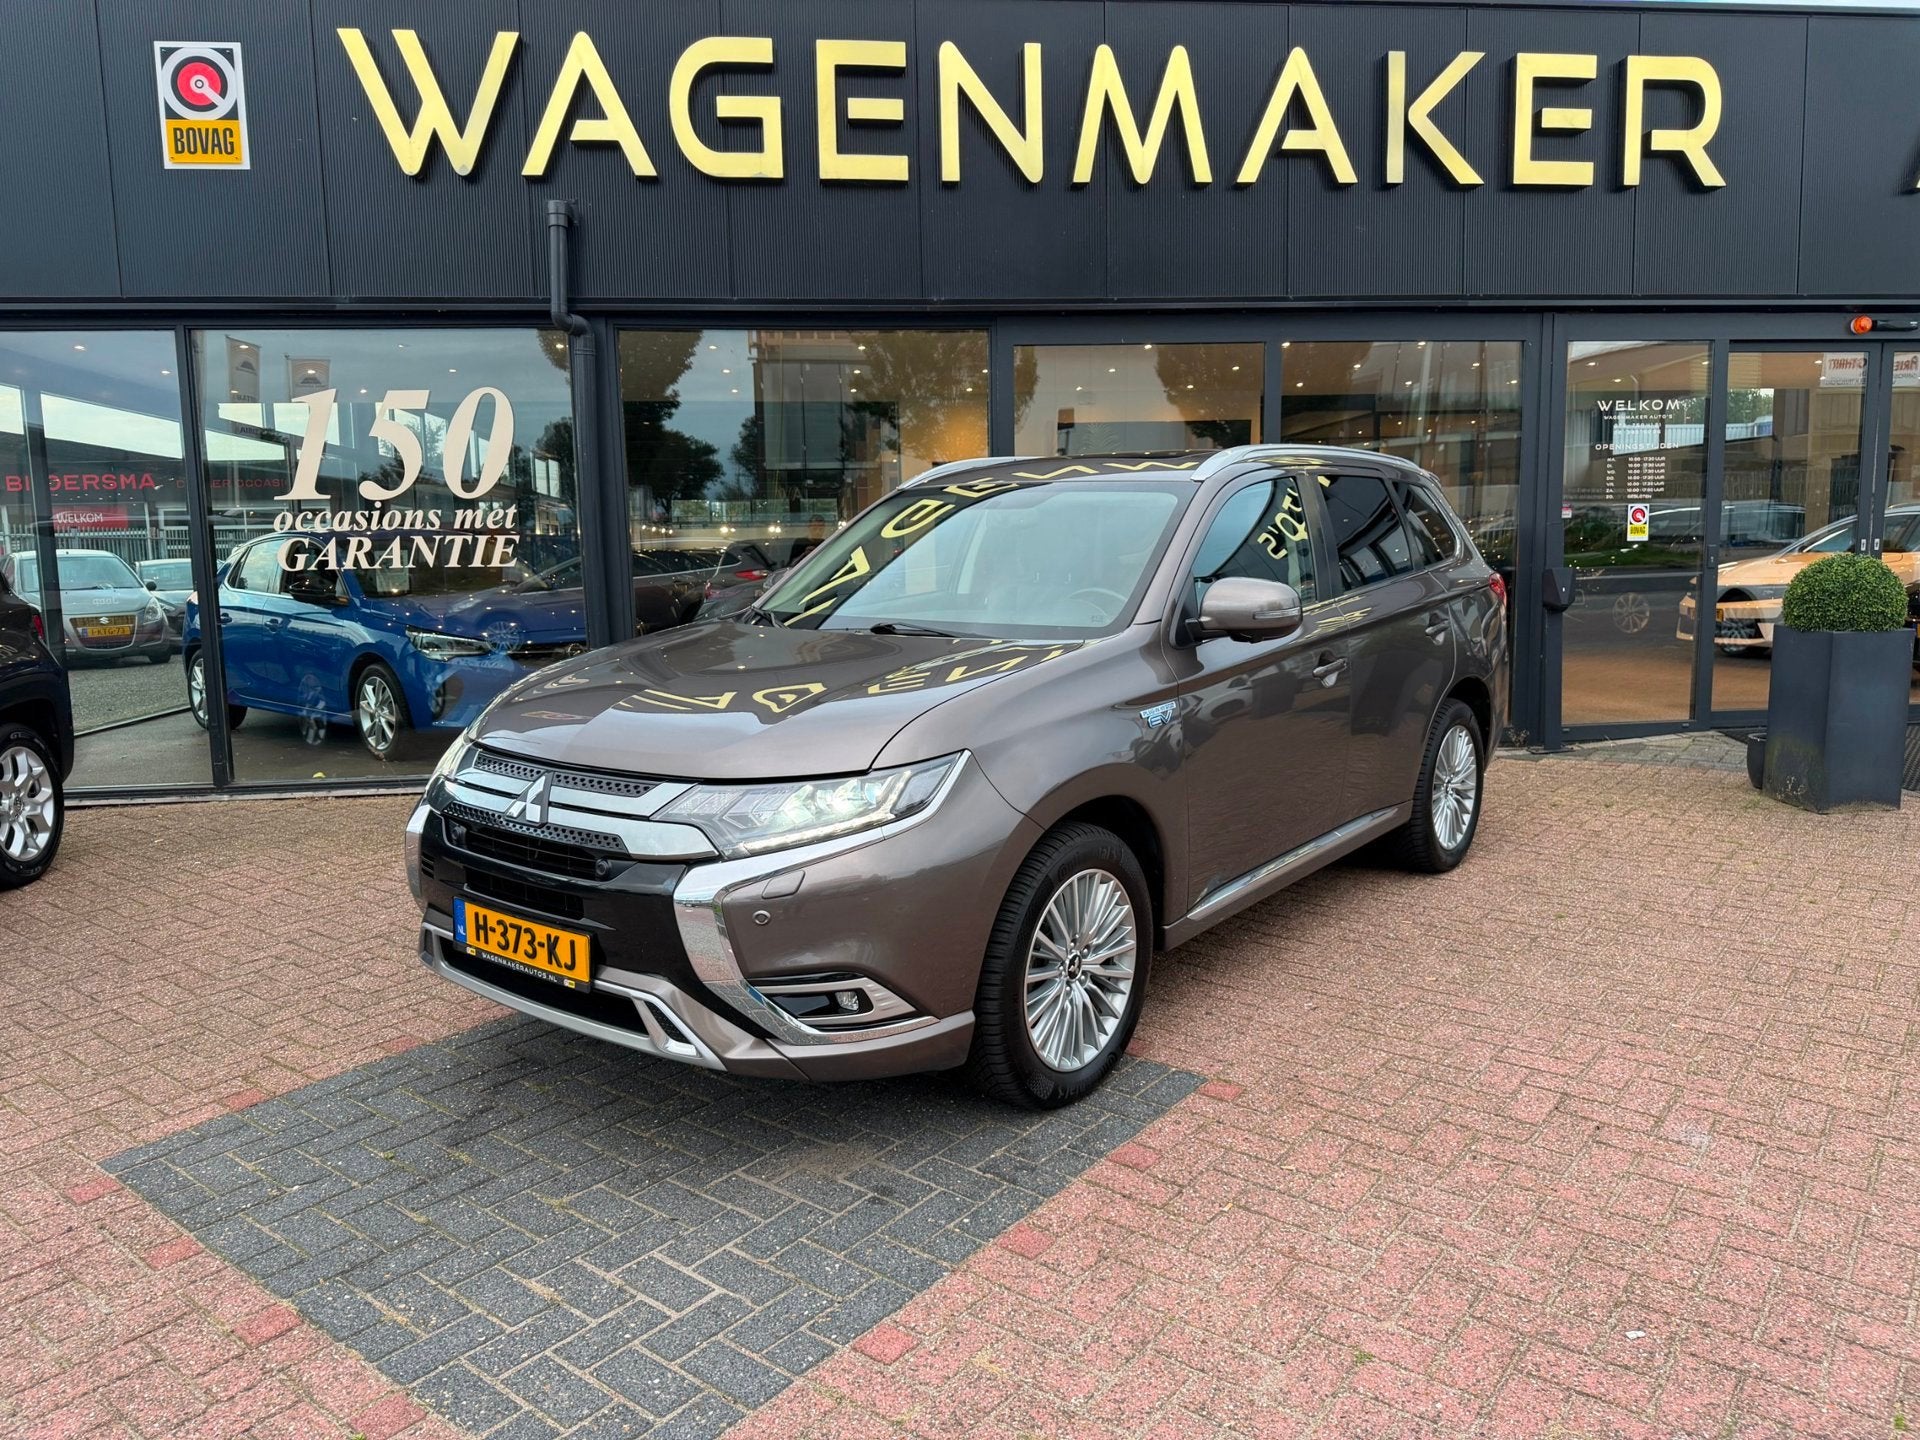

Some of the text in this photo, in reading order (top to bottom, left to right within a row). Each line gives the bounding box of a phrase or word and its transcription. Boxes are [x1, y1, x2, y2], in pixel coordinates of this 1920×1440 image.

[338, 28, 1726, 188] WAGENMAKER
[173, 127, 235, 156] BOVAG
[1597, 399, 1680, 412] WELKOM
[274, 387, 515, 501] 150
[273, 502, 517, 533] occasions met
[276, 535, 520, 573] GARANTIE
[1148, 709, 1173, 729] EV
[457, 911, 577, 971] NL H-373-KJ
[481, 952, 559, 983] WAGENMAKERAUTOS.NL
